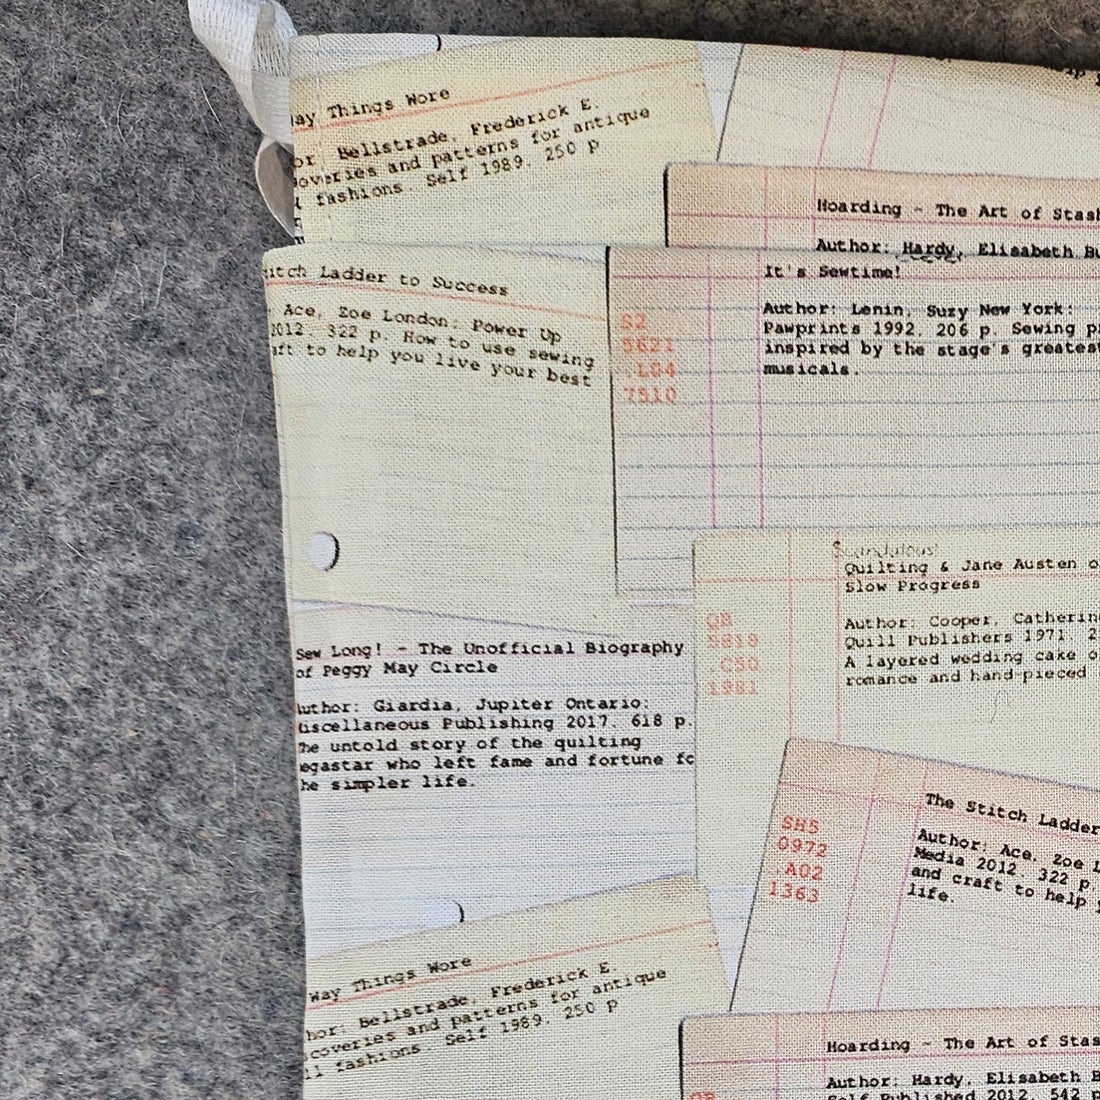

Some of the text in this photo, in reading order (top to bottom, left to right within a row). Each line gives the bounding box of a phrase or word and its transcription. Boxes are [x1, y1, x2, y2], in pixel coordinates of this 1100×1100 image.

[326, 89, 449, 119] Things Wore
[816, 198, 901, 219] Hoarding
[935, 203, 967, 217] The
[978, 204, 1008, 218] Art
[1020, 205, 1042, 221] of
[319, 265, 507, 296] Ladder to Success
[764, 264, 900, 279] It's Sewtime!
[926, 304, 969, 322] Suzy
[979, 303, 1011, 317] New
[765, 339, 850, 358] inspired
[860, 339, 883, 358] by
[893, 340, 925, 356] the
[937, 342, 1010, 359] stage's
[331, 642, 381, 659] Long!
[418, 642, 452, 655] The
[463, 641, 575, 655] Unofficial
[585, 640, 684, 657] Biography
[322, 659, 498, 679] Peggy May Circle
[925, 792, 955, 809] The
[965, 800, 1027, 823] Stitch
[1037, 813, 1100, 835] Ladder
[1052, 853, 1084, 870] Zoe
[911, 866, 942, 880] and
[952, 874, 1002, 892] craft
[1015, 884, 1034, 898] to
[1044, 887, 1087, 910] help
[985, 1070, 1081, 1085] Elisabeth
